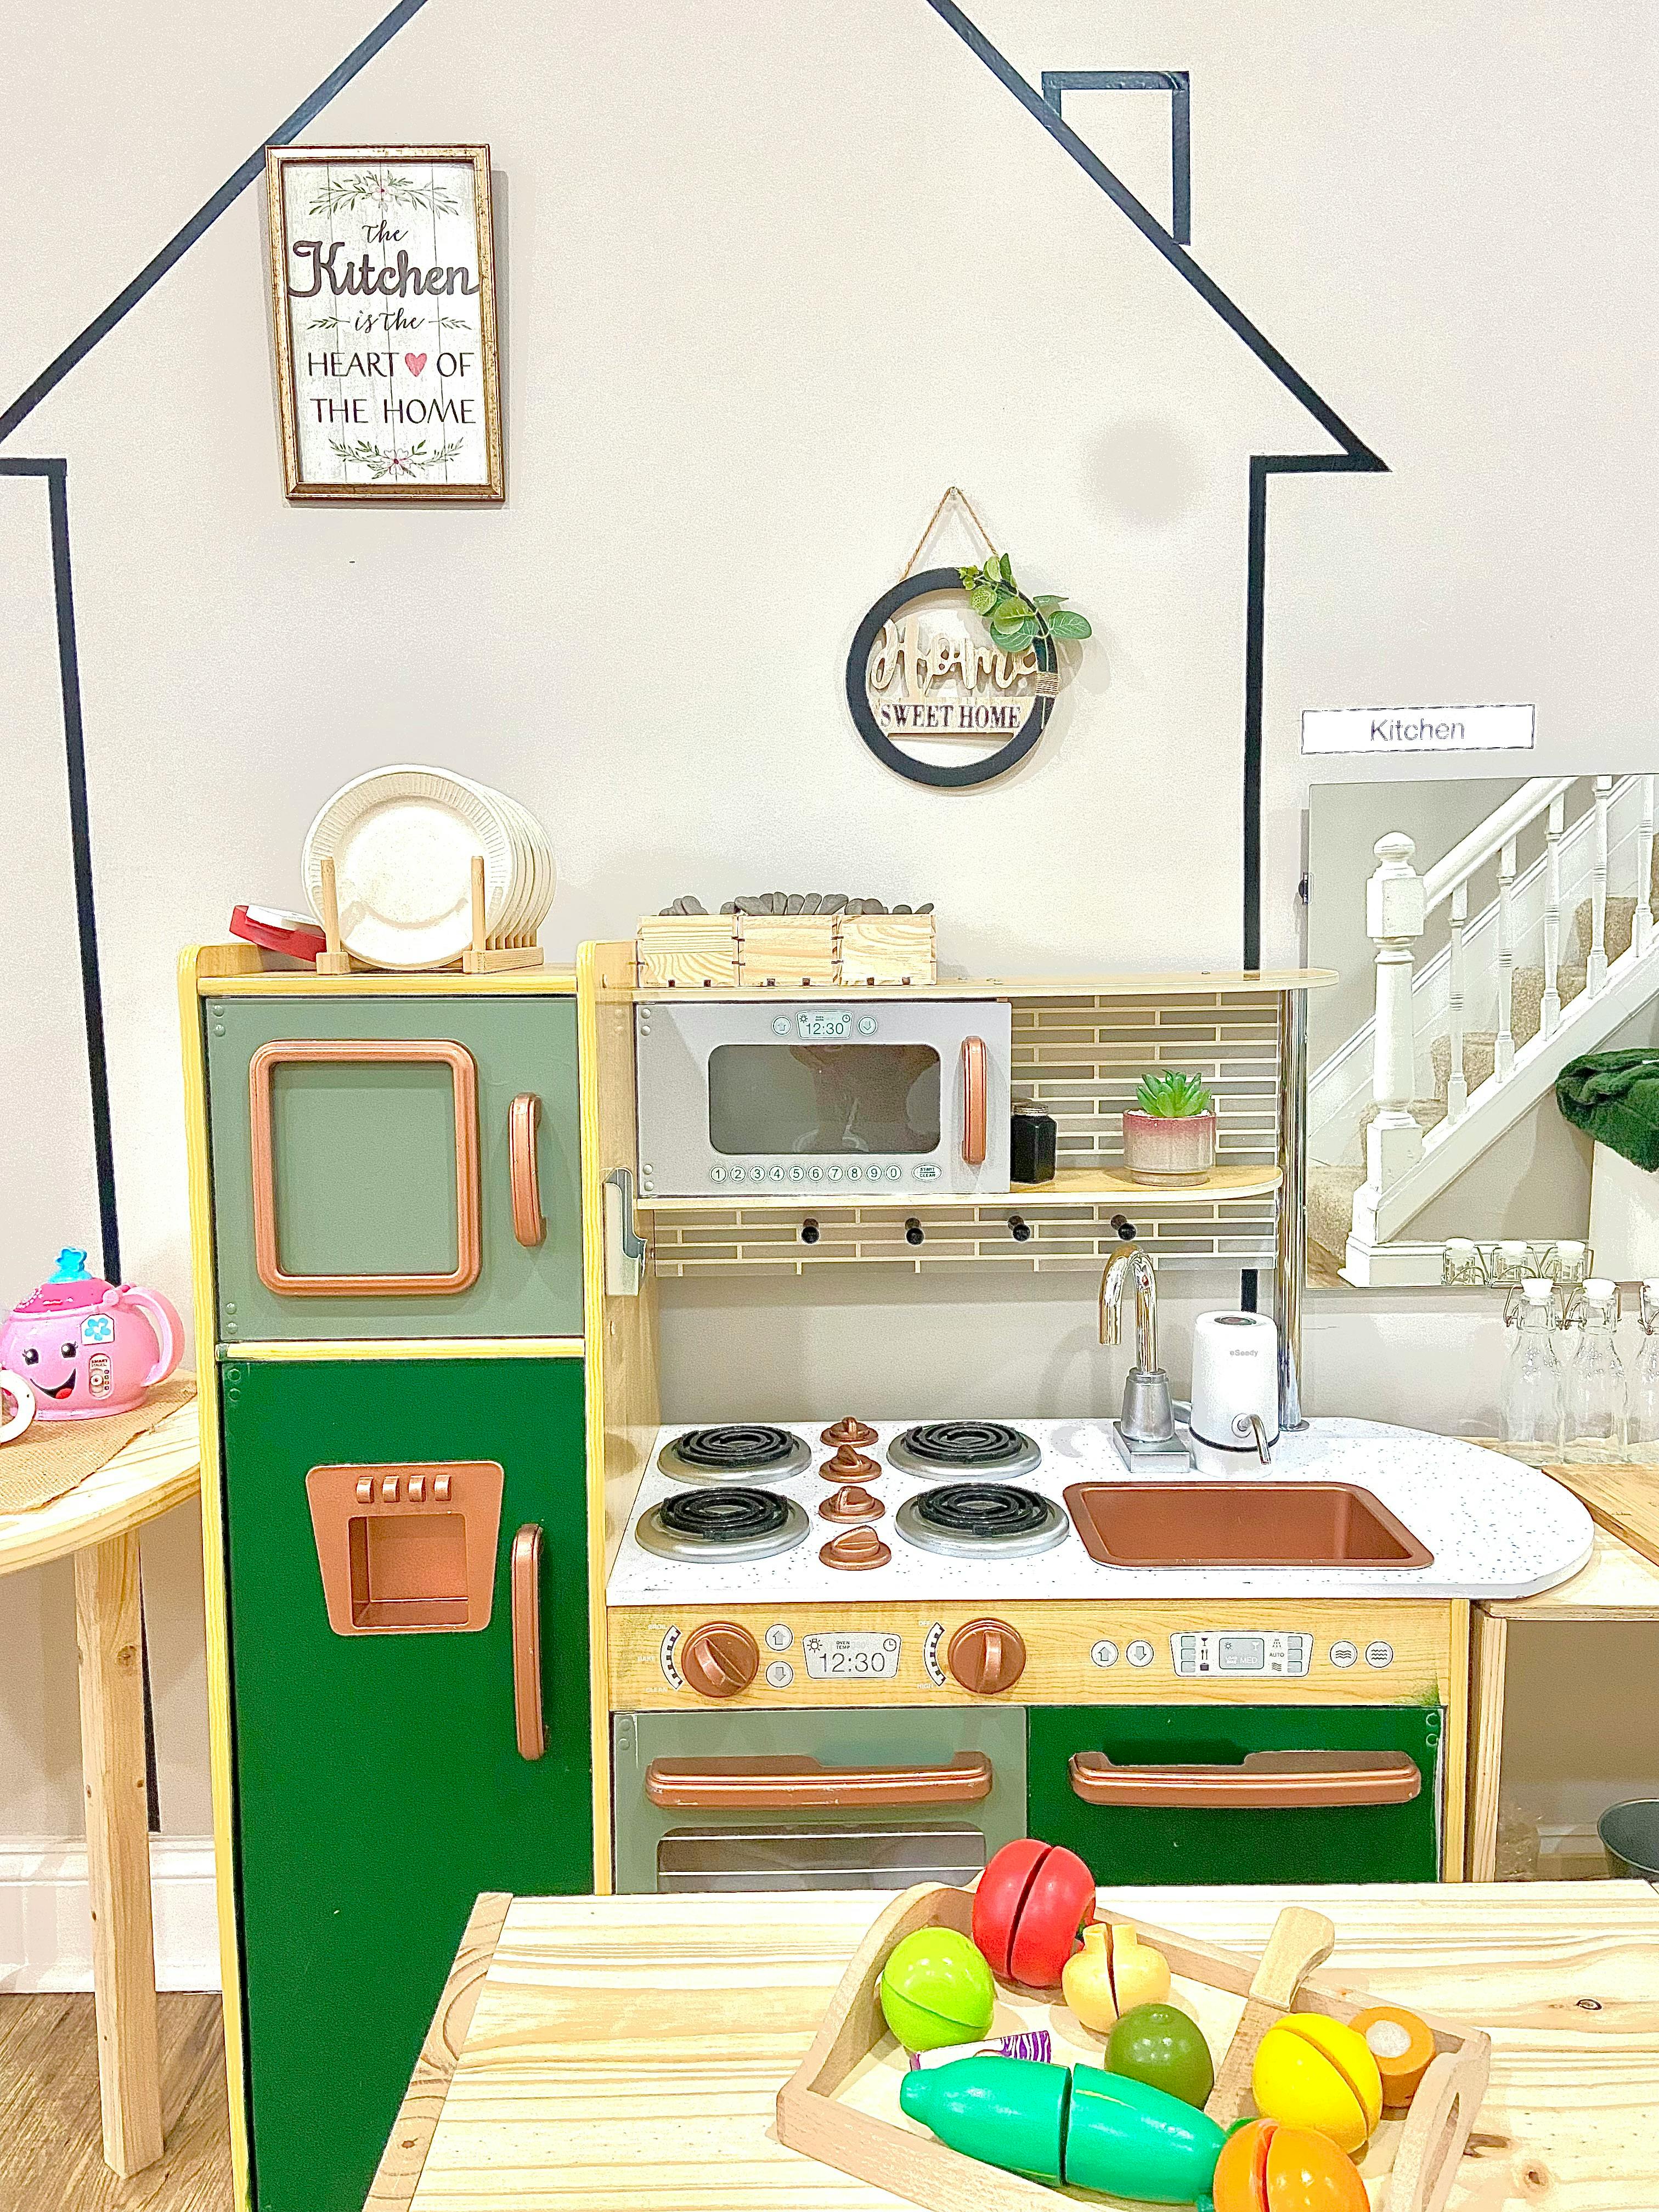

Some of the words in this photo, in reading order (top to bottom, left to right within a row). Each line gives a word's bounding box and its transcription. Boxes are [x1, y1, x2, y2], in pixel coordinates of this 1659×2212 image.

[287, 240, 481, 298] Kitchen
[308, 352, 399, 377] HEART
[437, 352, 475, 377] OF
[309, 398, 368, 424] THE
[383, 398, 476, 424] HOME
[880, 703, 954, 729] SWEET
[958, 705, 1022, 729] HOME
[1370, 718, 1465, 741] Kitchen
[806, 1023, 844, 1035] 12:30
[715, 1169, 720, 1179] 1
[735, 1169, 742, 1179] 2
[754, 1169, 761, 1179] 3
[774, 1169, 781, 1178] 4
[793, 1169, 800, 1178] 5
[812, 1169, 819, 1178] 6
[832, 1169, 839, 1178] 7
[851, 1168, 858, 1178] 8
[871, 1168, 878, 1178] 9
[890, 1168, 897, 1178] 0
[820, 1652, 885, 1672] 12:30
